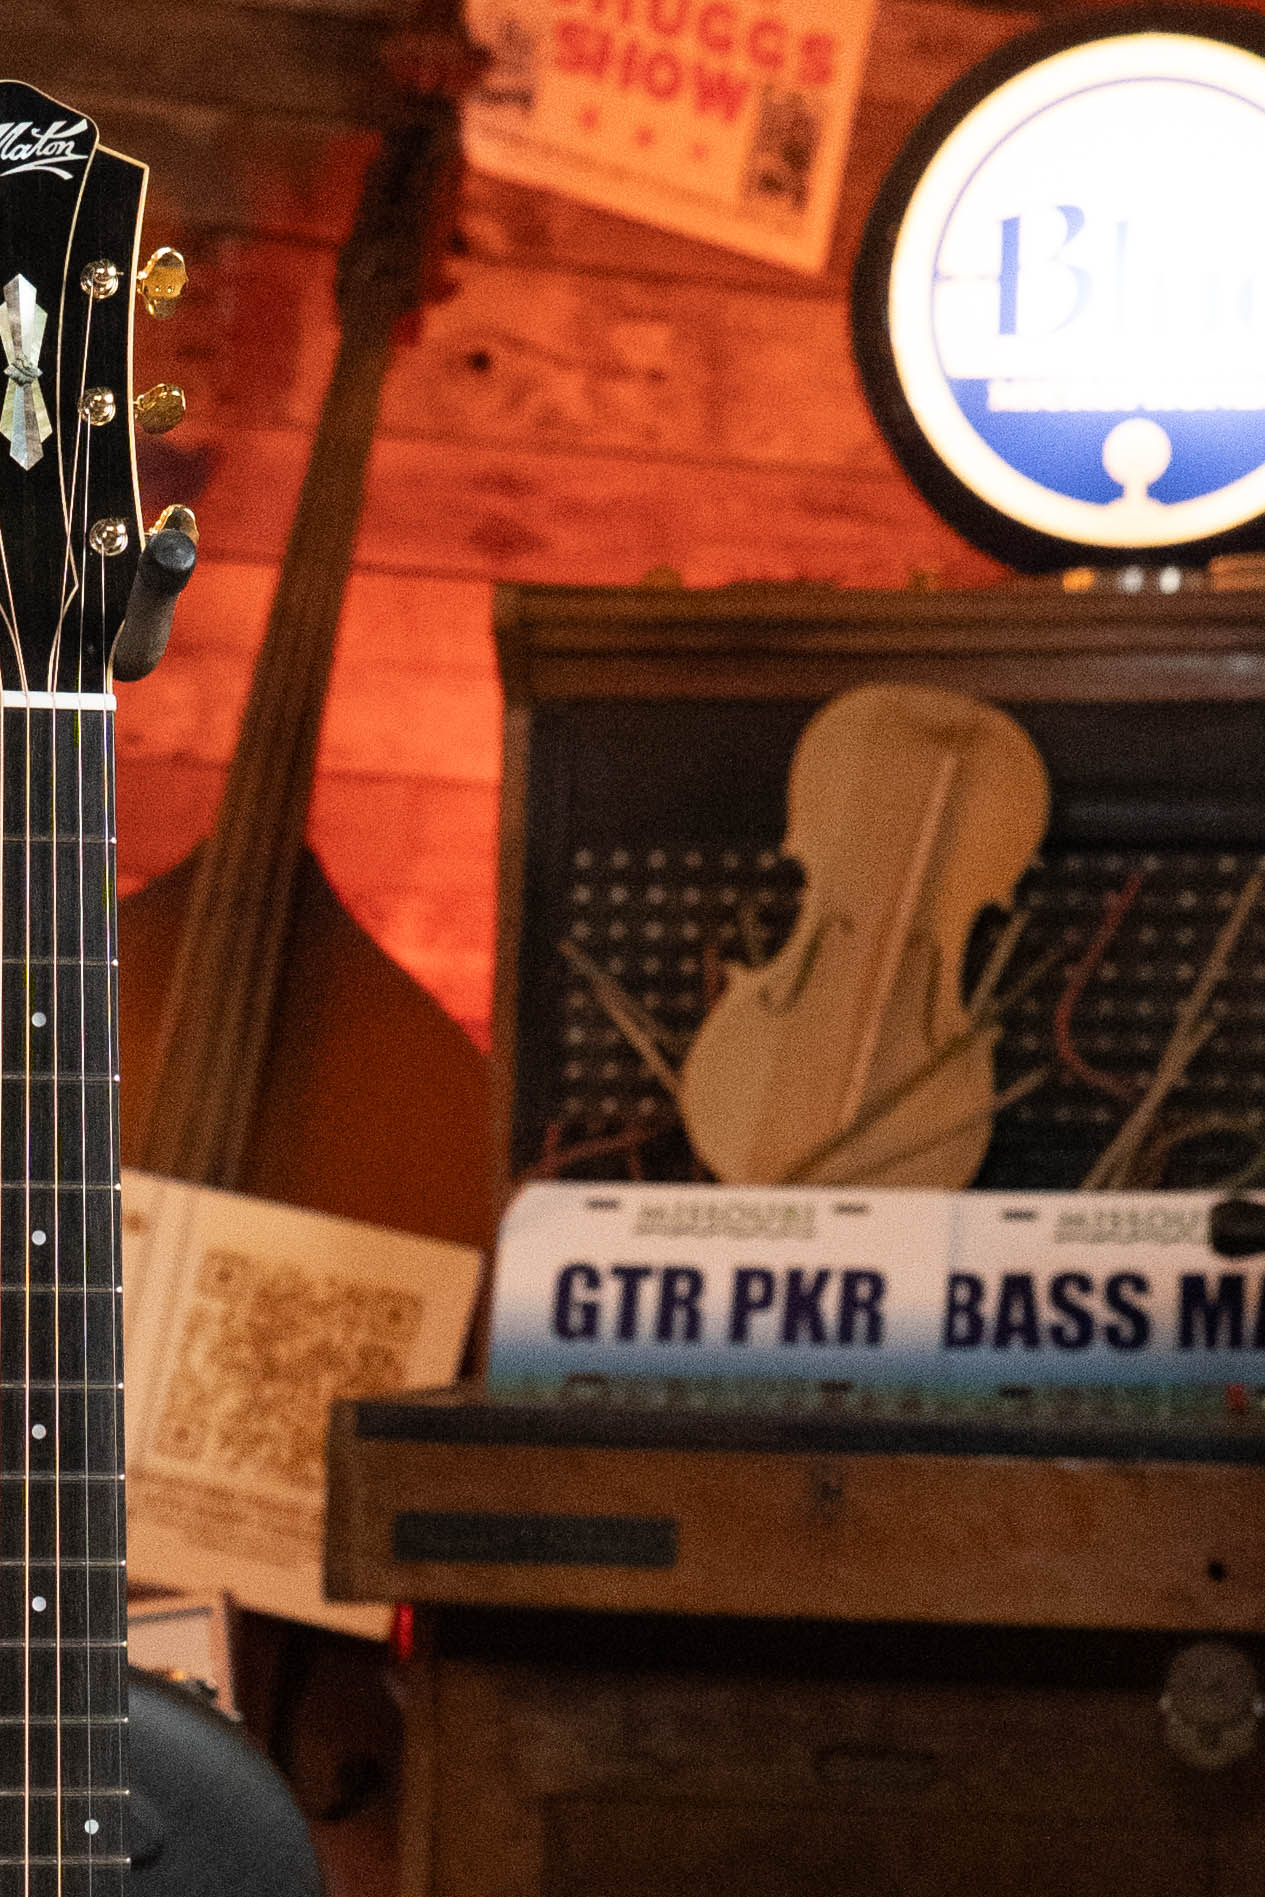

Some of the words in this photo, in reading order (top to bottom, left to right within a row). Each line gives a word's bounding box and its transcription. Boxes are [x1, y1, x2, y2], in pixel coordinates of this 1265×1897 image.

[552, 1263, 705, 1342] GTR
[730, 1265, 887, 1344] PKR
[943, 1271, 1152, 1350] BASS
